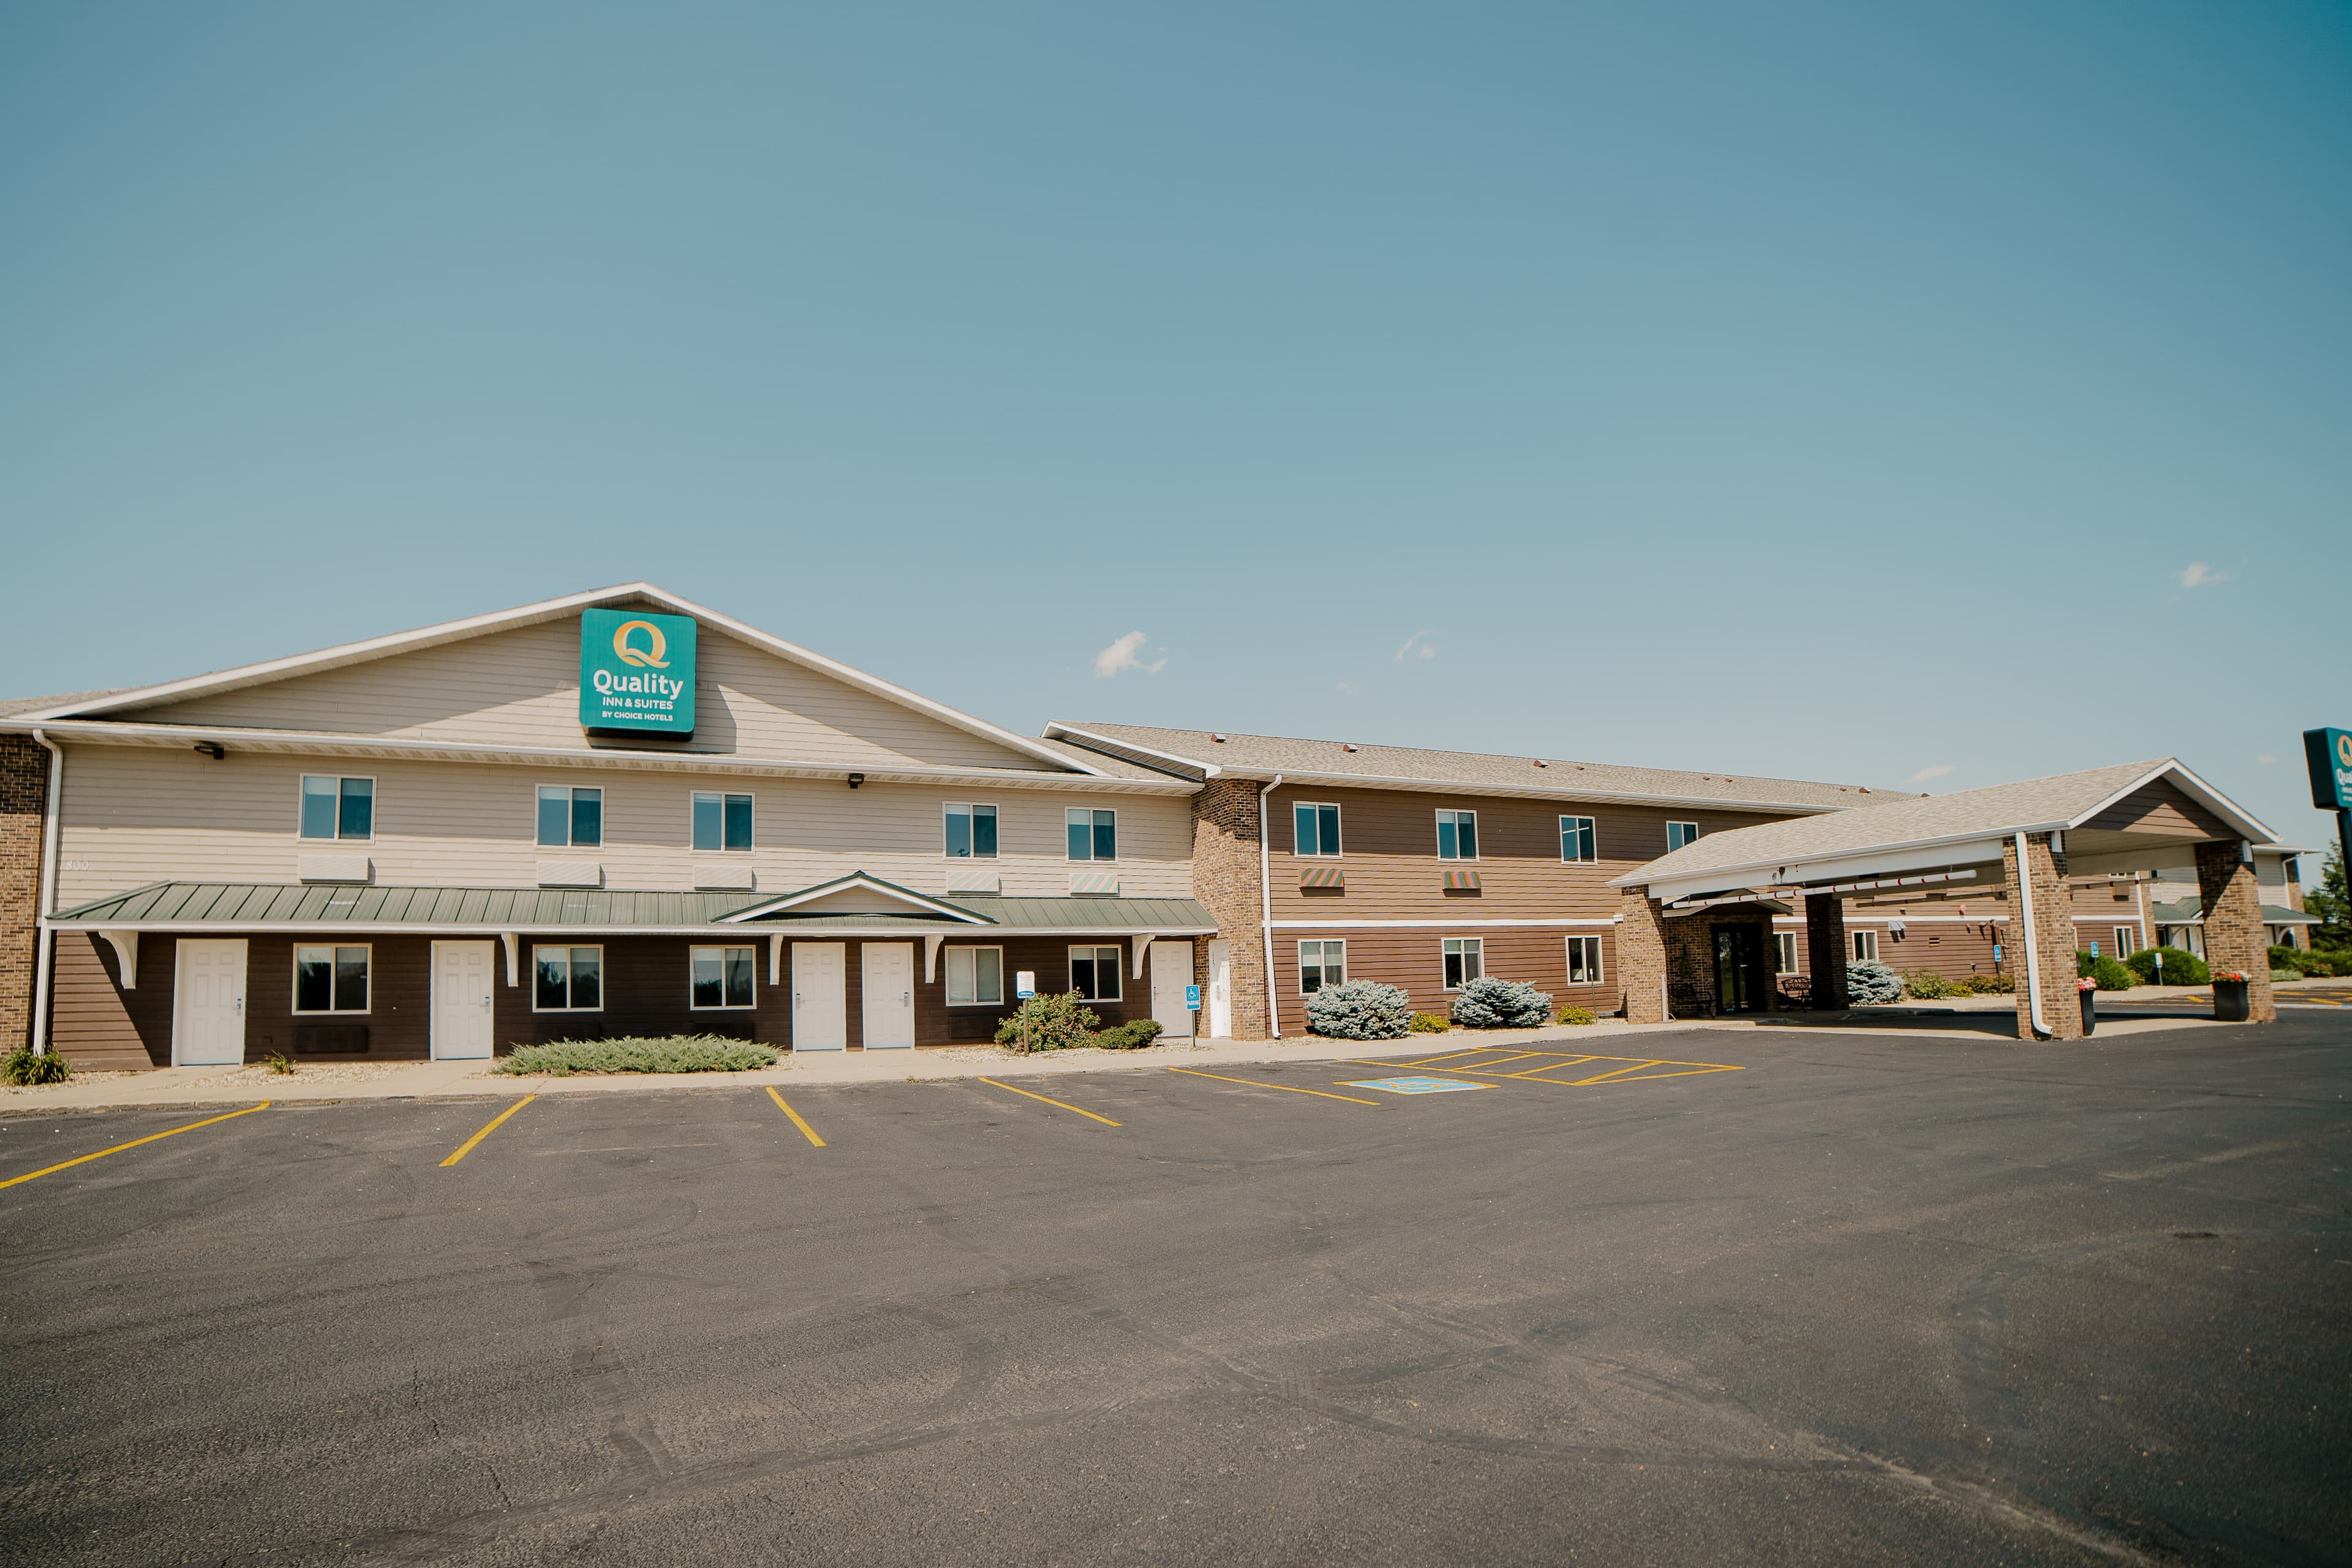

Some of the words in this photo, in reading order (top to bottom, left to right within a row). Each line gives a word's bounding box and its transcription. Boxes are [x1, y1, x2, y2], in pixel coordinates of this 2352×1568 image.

[613, 620, 670, 668] Q
[594, 669, 683, 699] Quality
[602, 696, 623, 707] INN
[625, 698, 633, 707] &
[635, 699, 673, 710] SUITES
[614, 711, 643, 720] CHOICE
